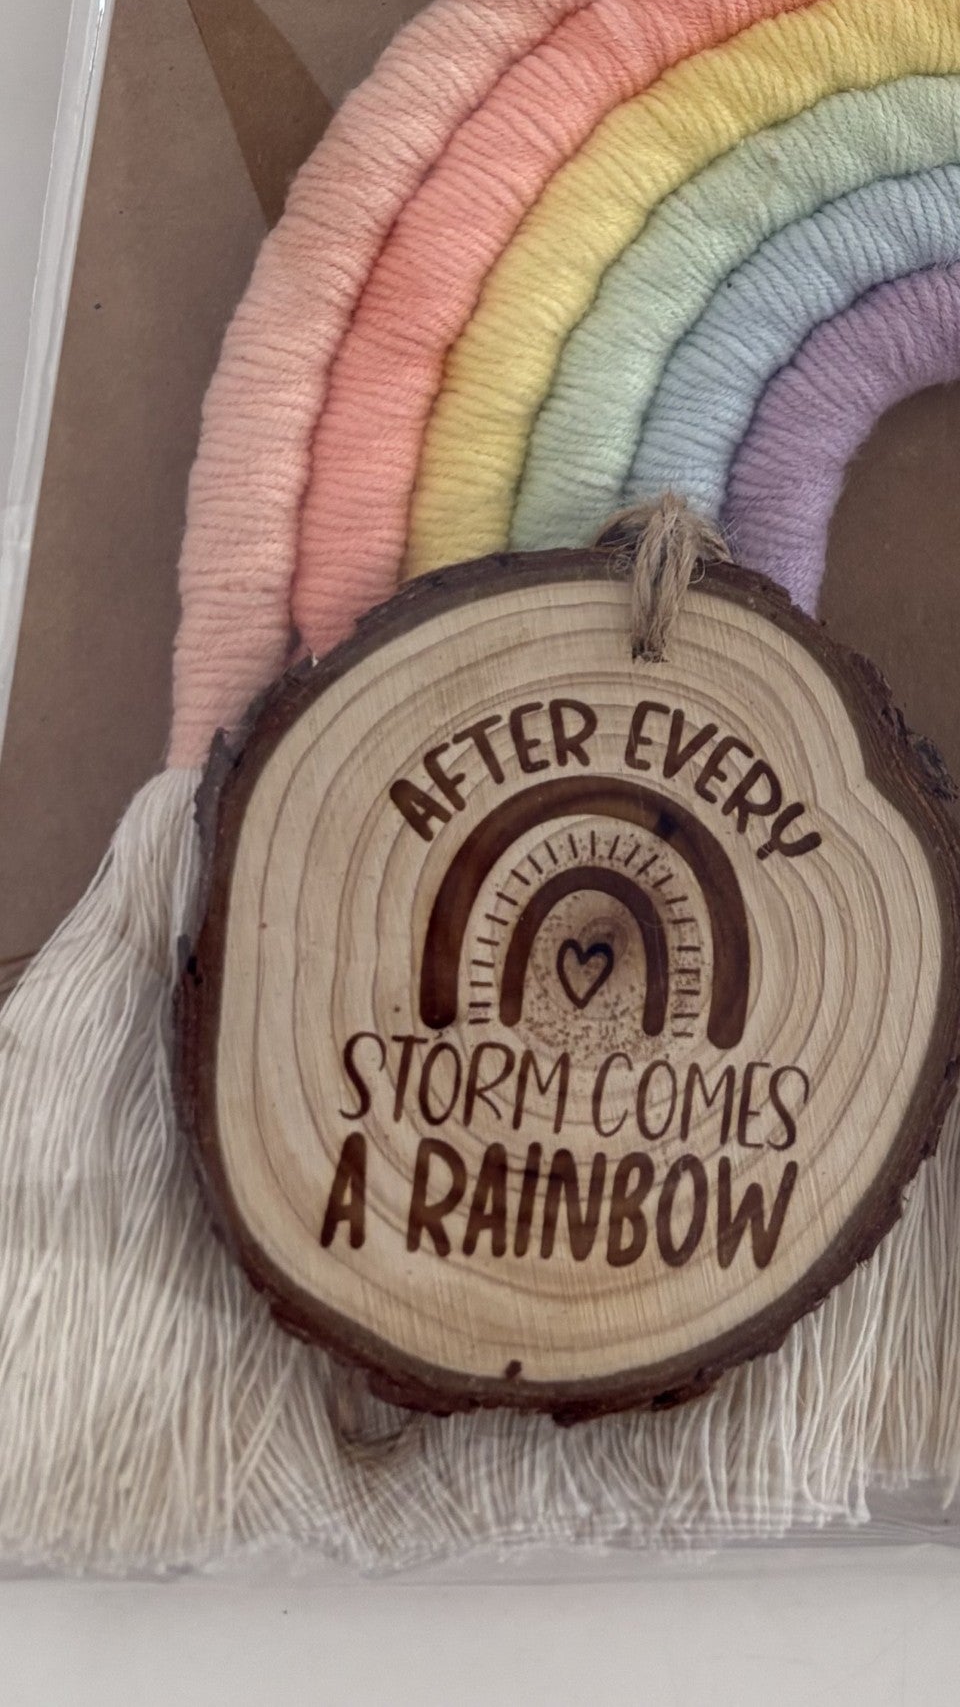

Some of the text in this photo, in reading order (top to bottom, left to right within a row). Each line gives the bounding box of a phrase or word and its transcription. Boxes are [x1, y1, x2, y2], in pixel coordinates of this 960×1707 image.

[388, 698, 823, 861] AFTER EVERY
[338, 1031, 811, 1152] STORM COMES
[320, 1131, 799, 1270] A RAINBOW
